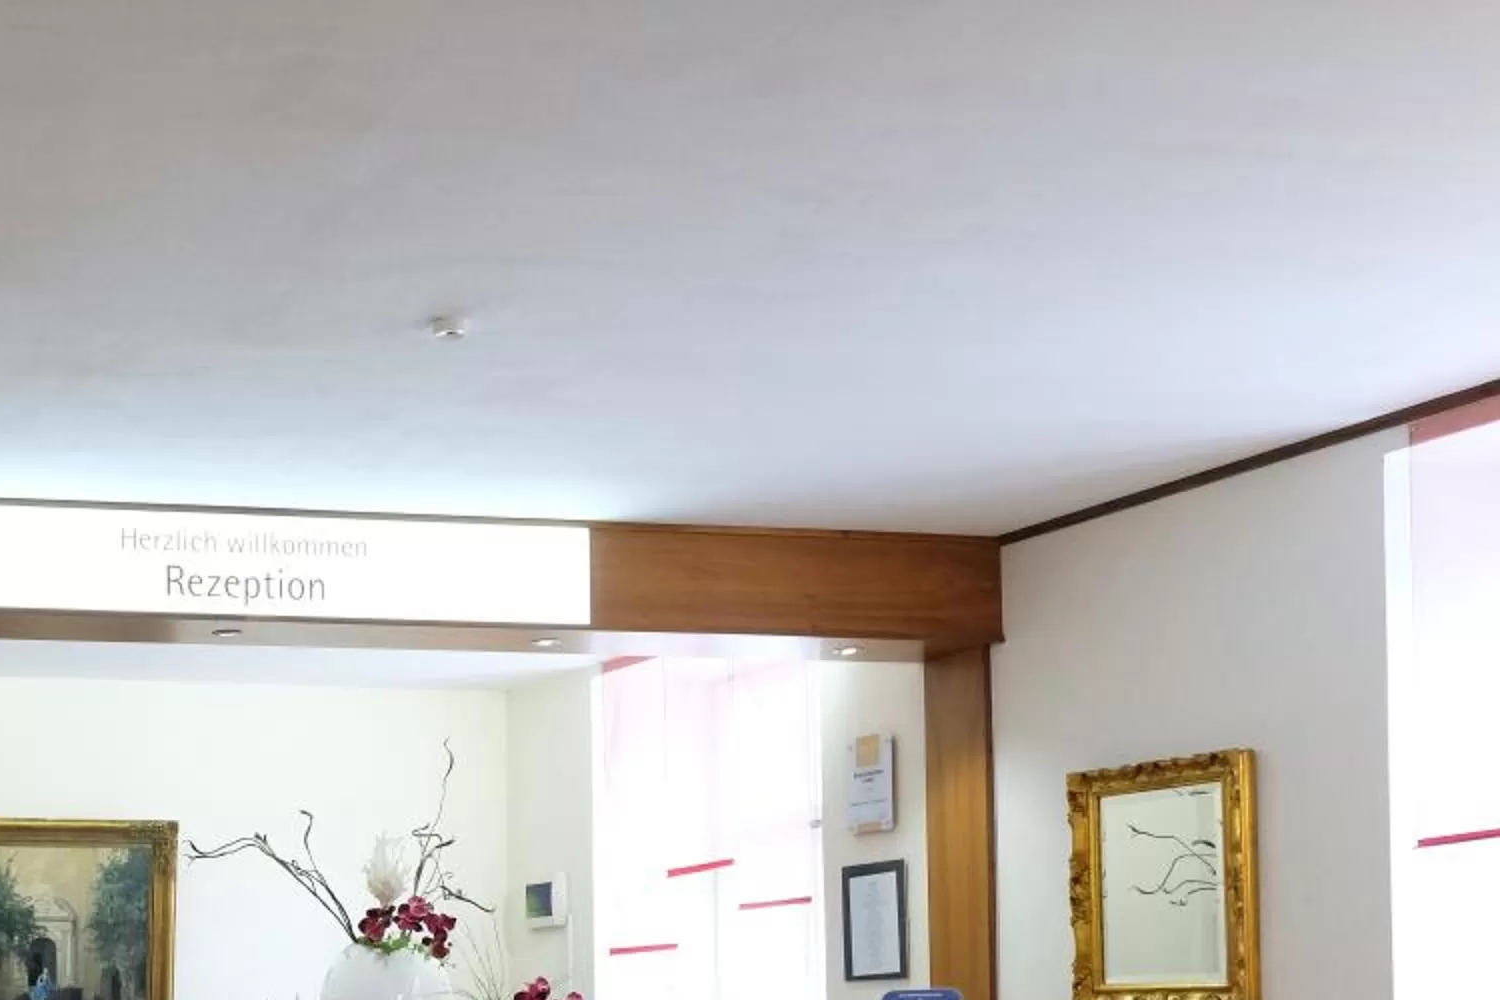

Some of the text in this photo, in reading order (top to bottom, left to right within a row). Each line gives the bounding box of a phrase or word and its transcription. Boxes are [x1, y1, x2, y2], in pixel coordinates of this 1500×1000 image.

[120, 527, 368, 557] Herzlich willkommen
[166, 564, 325, 606] Rezeption
